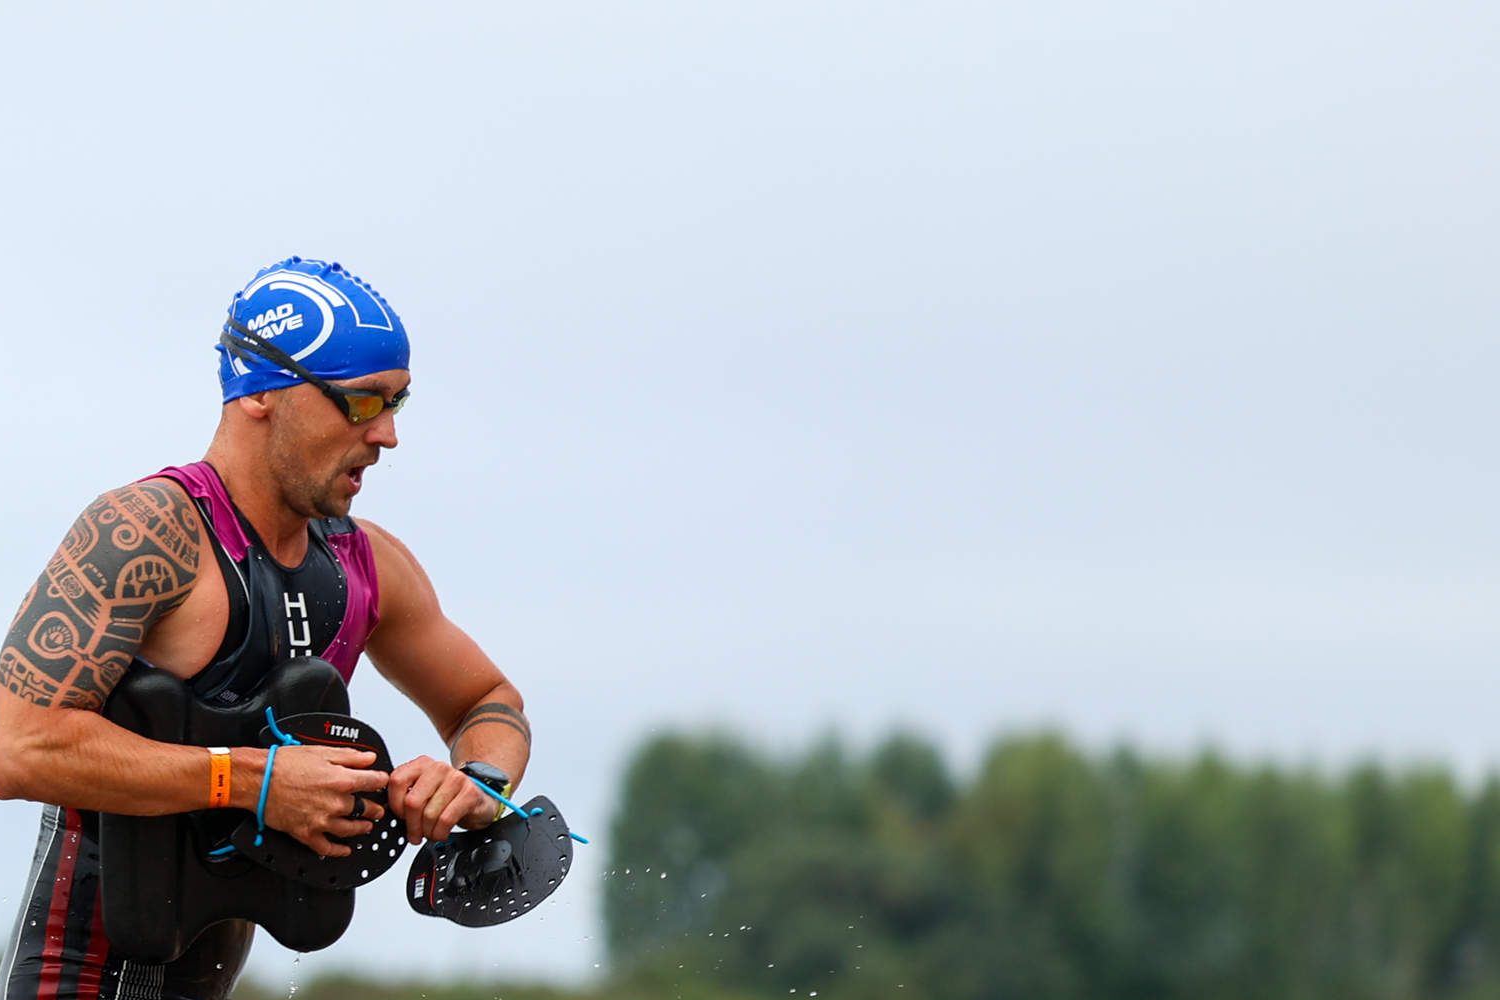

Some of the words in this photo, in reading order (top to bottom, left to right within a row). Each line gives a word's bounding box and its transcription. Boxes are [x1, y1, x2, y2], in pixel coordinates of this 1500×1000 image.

[247, 303, 294, 331] MAD
[283, 592, 312, 659] HU
[323, 720, 360, 740] TITAN
